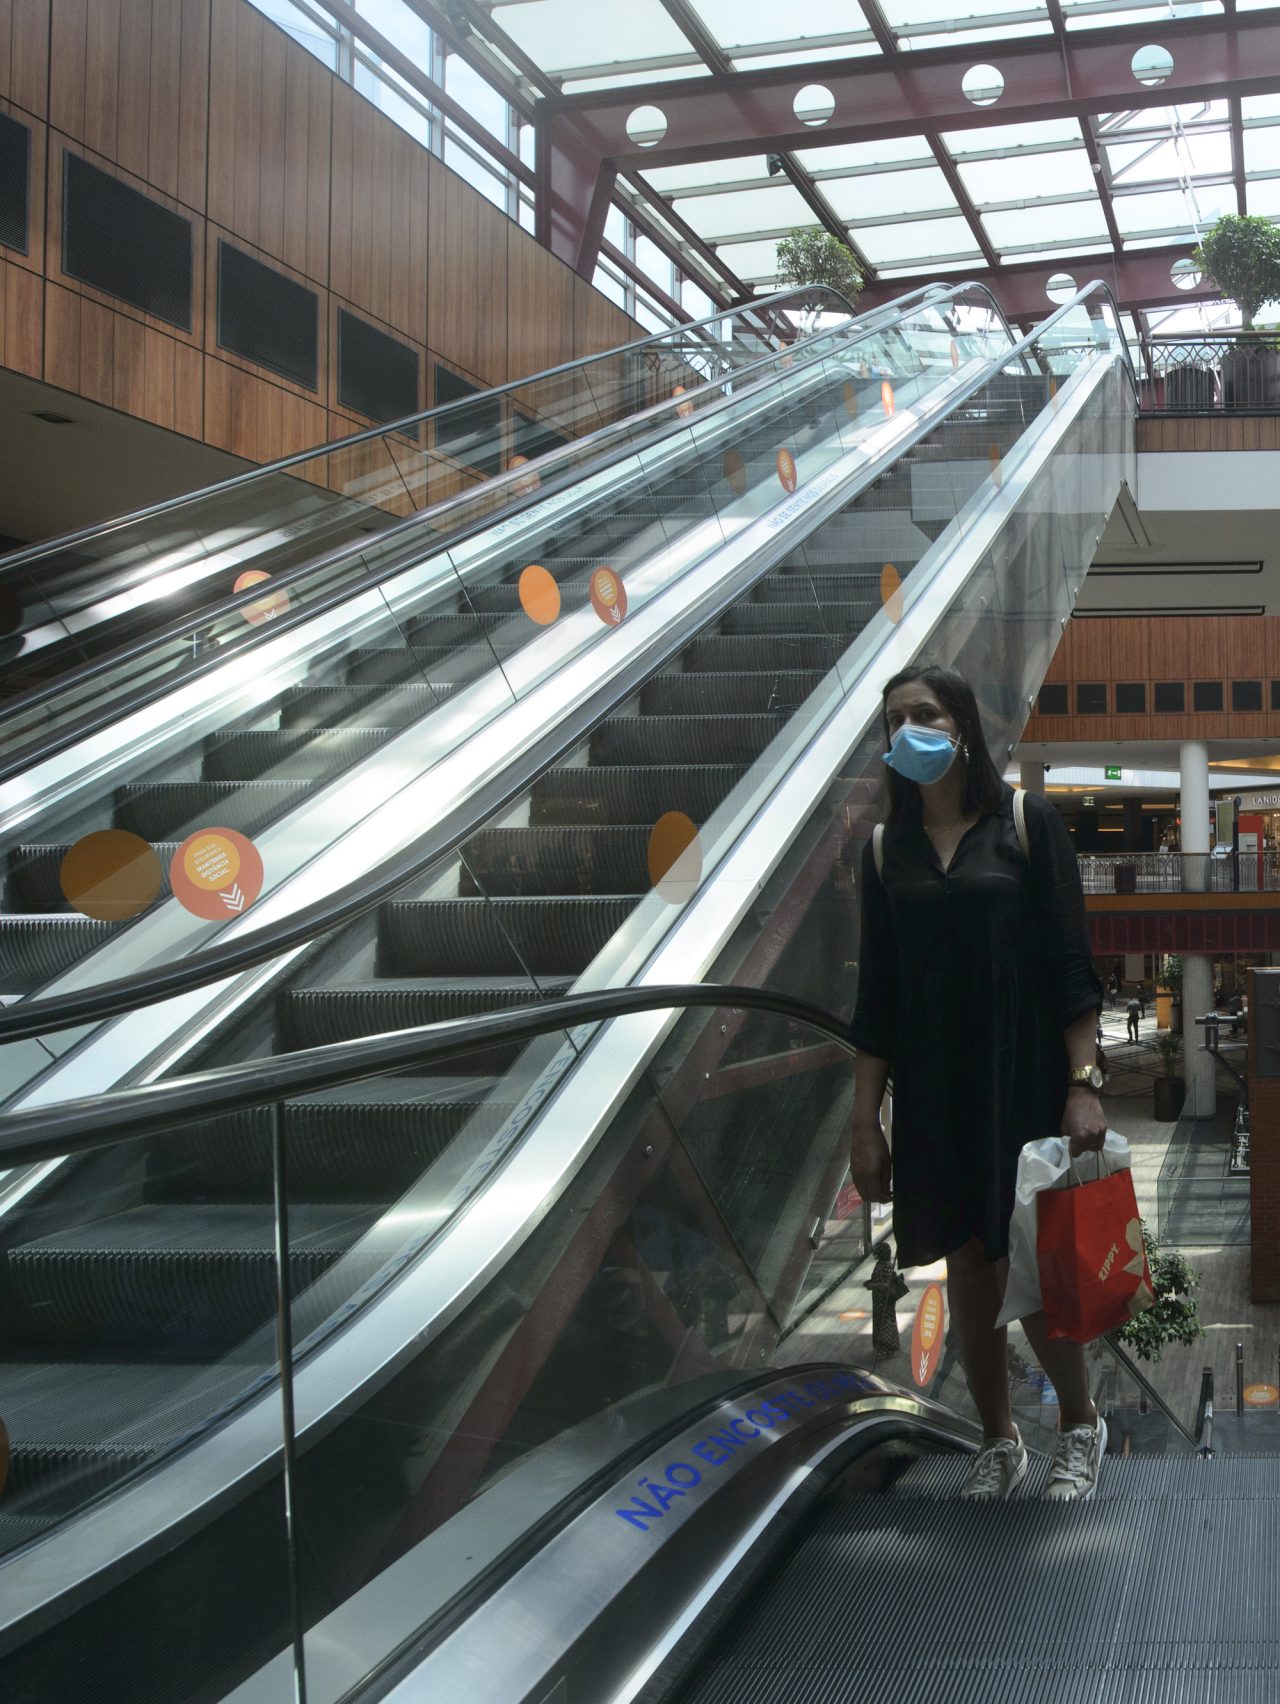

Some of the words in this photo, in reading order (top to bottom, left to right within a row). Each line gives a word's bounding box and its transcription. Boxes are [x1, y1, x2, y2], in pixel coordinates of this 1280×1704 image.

[196, 852, 227, 872] MANTENHA
[1098, 1243, 1119, 1283] ZIPPY
[615, 1462, 701, 1532] NÃO
[691, 1390, 816, 1467] ENCOSTE
